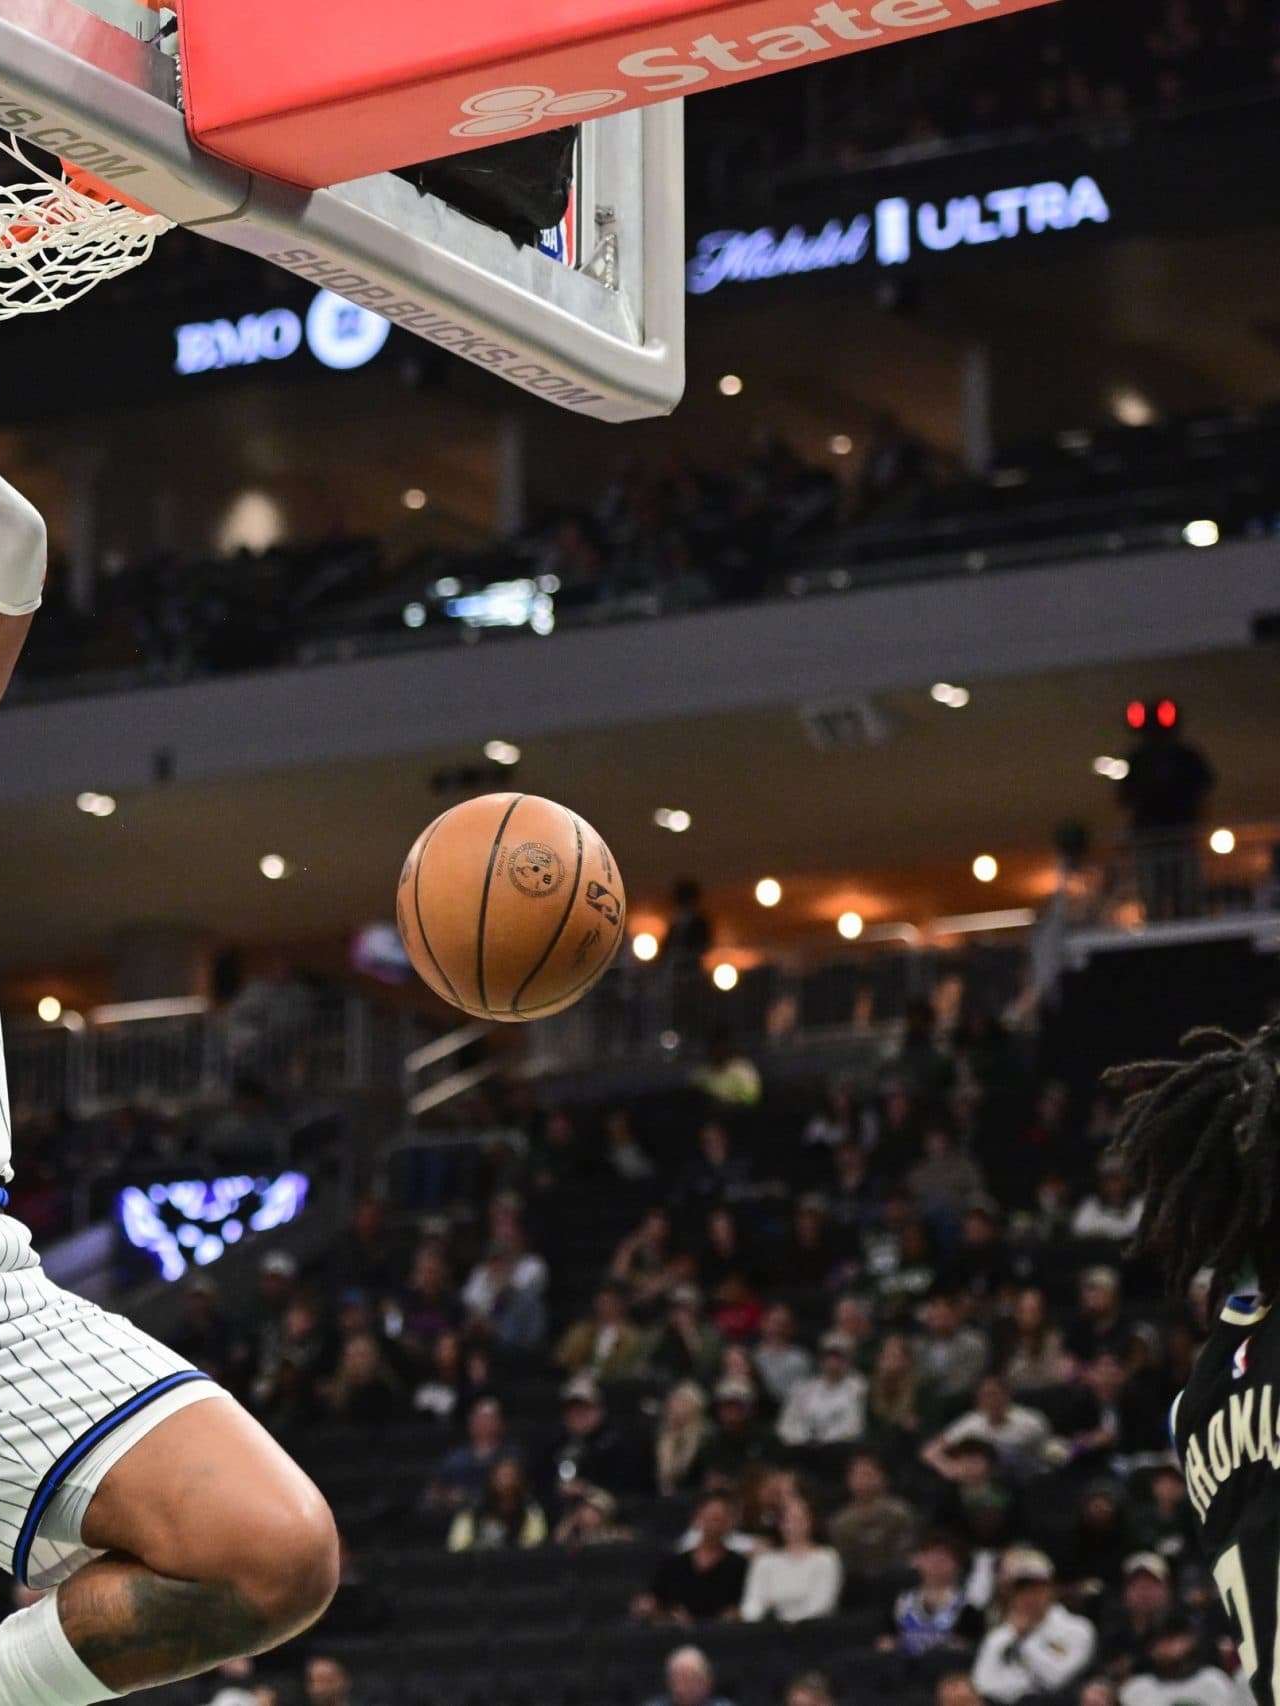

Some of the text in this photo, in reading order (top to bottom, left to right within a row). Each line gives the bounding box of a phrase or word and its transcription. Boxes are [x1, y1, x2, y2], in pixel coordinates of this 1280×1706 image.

[618, 0, 952, 93] State
[539, 226, 558, 253] BA
[919, 175, 1110, 251] ULTRA
[175, 308, 302, 374] BMO
[267, 248, 607, 406] SHOP.BUCKS.COM
